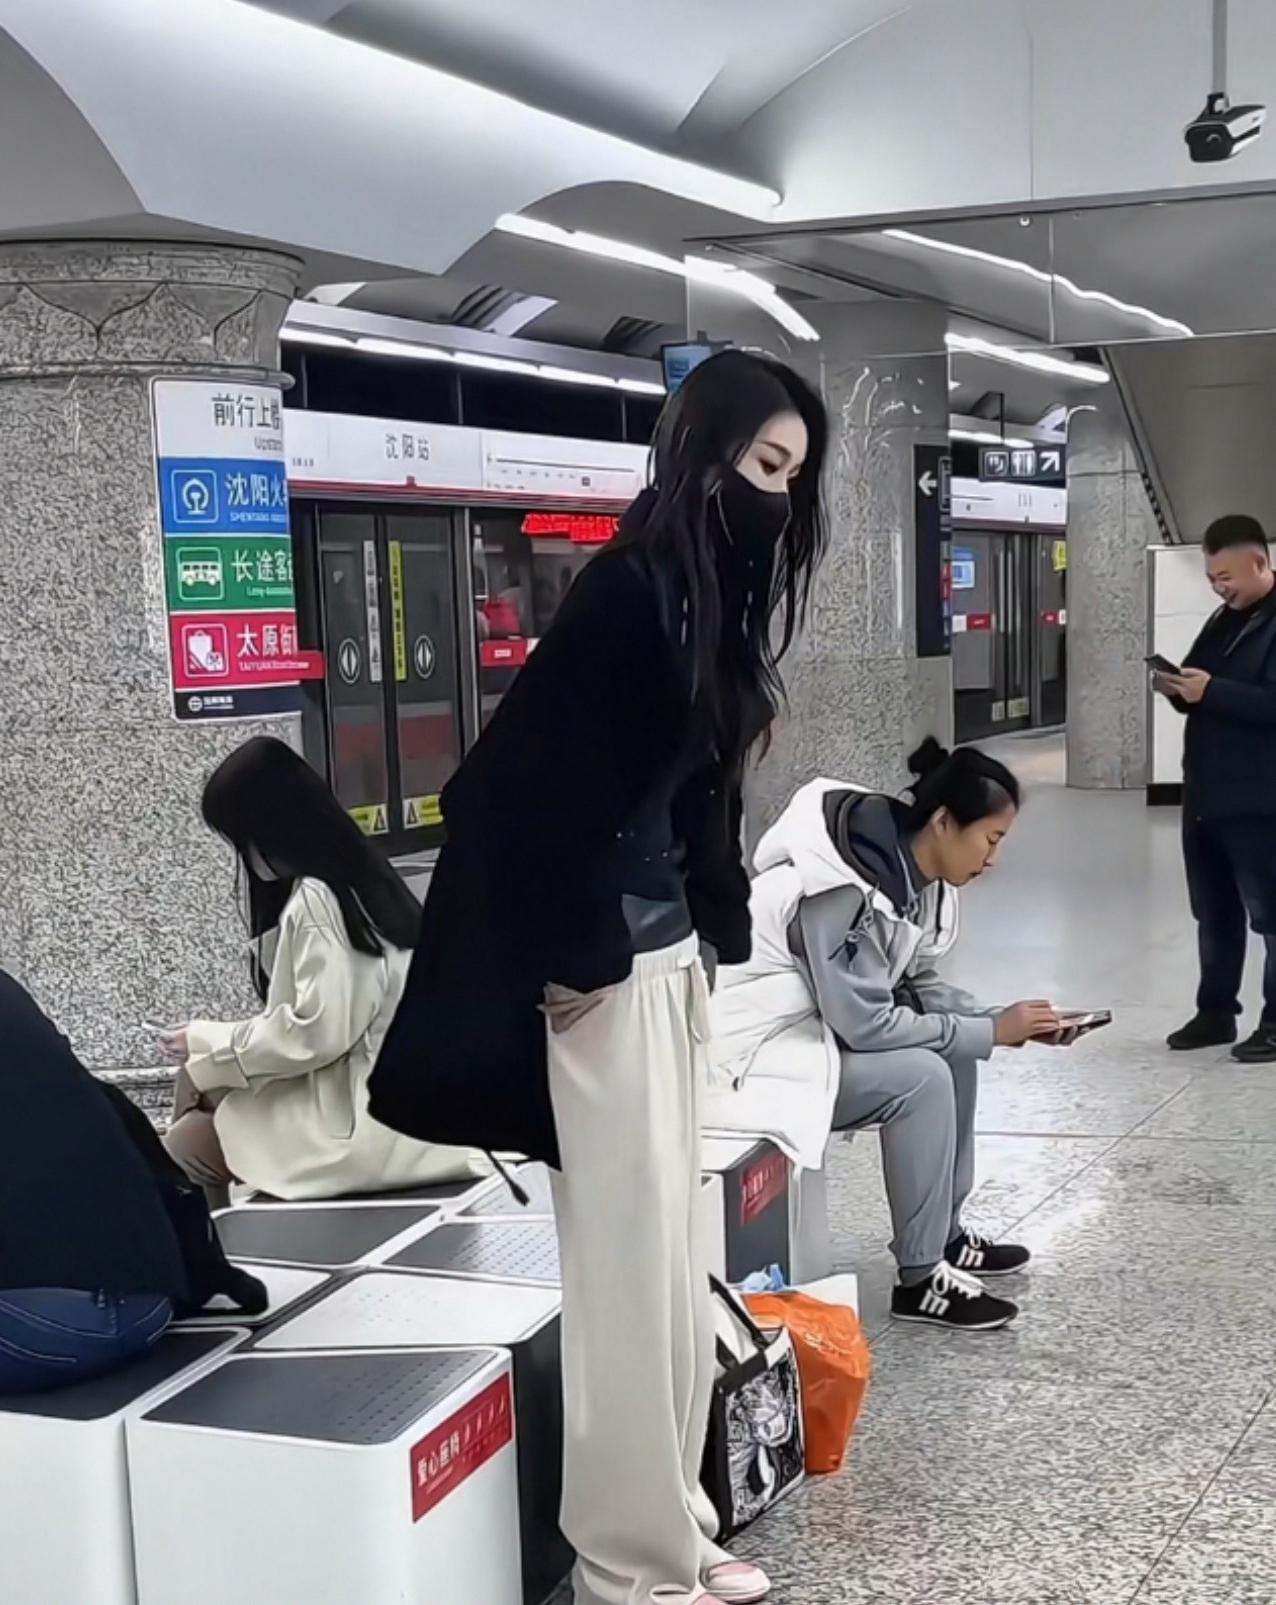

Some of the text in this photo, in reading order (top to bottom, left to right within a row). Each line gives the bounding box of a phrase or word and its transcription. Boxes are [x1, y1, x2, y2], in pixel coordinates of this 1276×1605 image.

[224, 472, 287, 507] 沈阳火
[230, 549, 293, 582] 长途客
